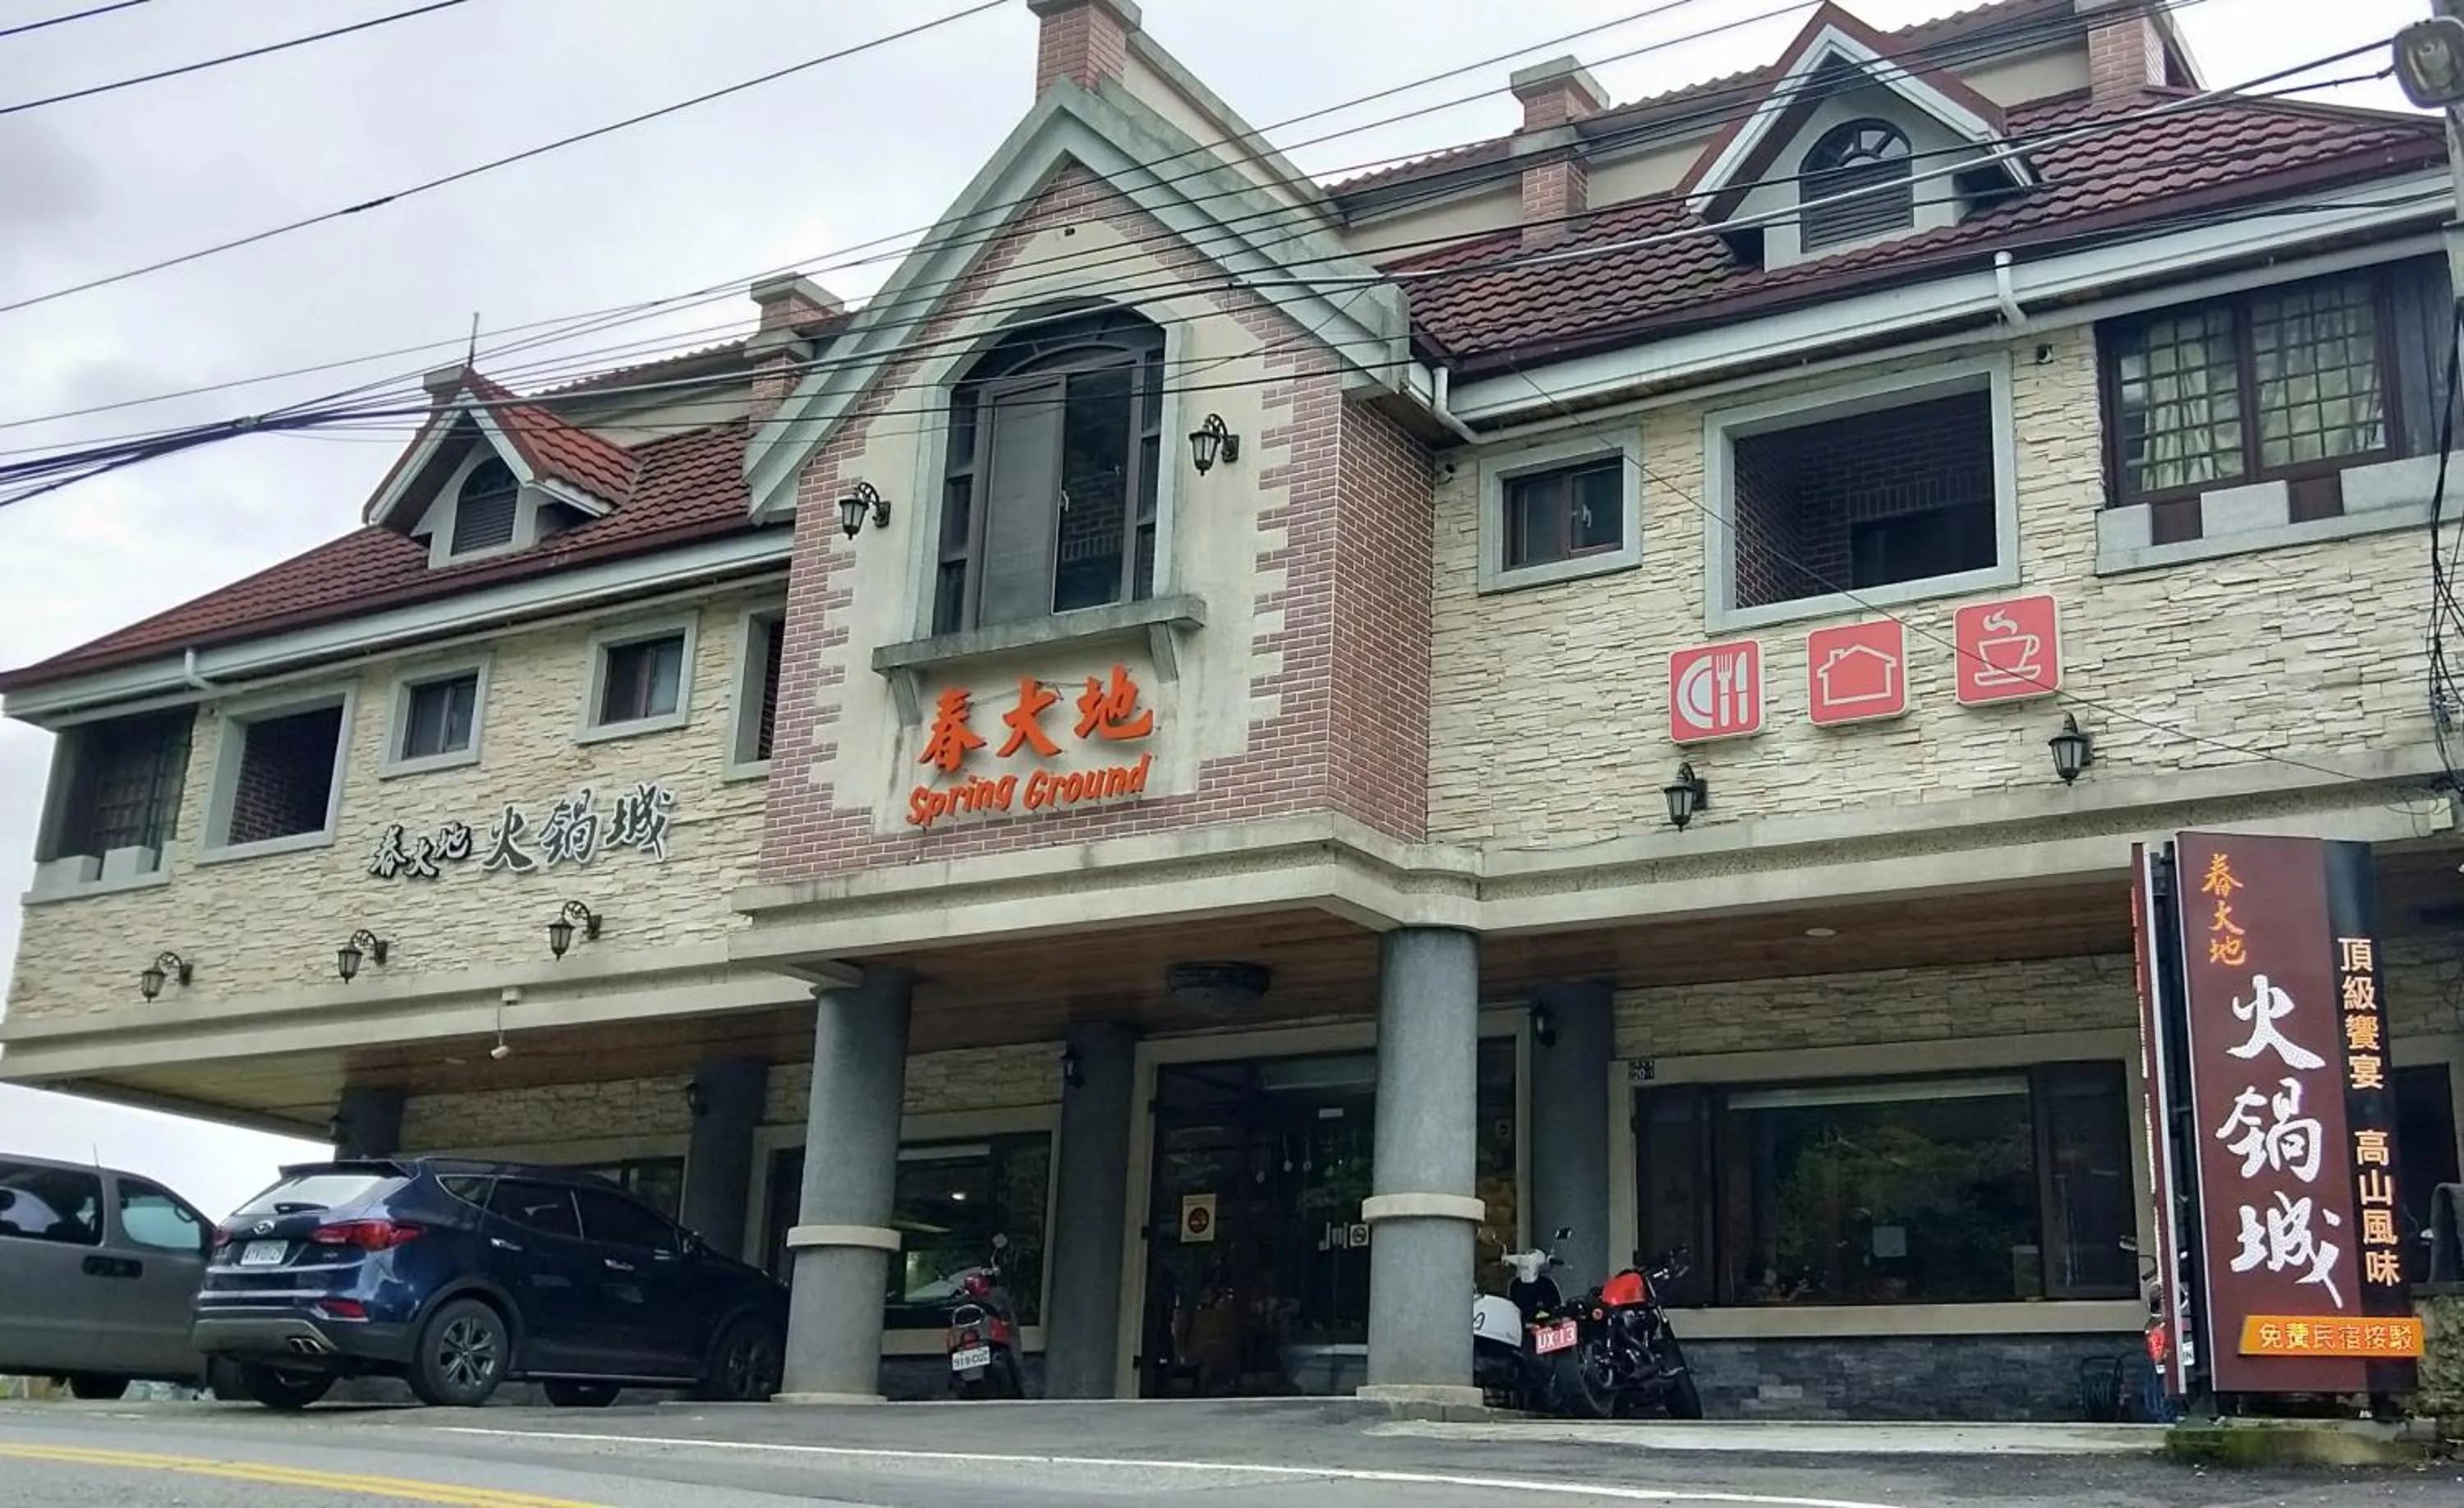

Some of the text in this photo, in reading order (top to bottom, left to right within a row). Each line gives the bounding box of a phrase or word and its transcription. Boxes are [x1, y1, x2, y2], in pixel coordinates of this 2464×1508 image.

[917, 664, 1153, 774] 春大地
[369, 783, 675, 879] 春大地 火鍋城
[906, 752, 1152, 826] Spring Ground
[2200, 853, 2247, 966] 春大地
[2215, 973, 2343, 1309] 火鍋城
[2338, 937, 2402, 1287] 頂級饗宴 高山風味
[2259, 1322, 2415, 1350] 免費民宿接駁
